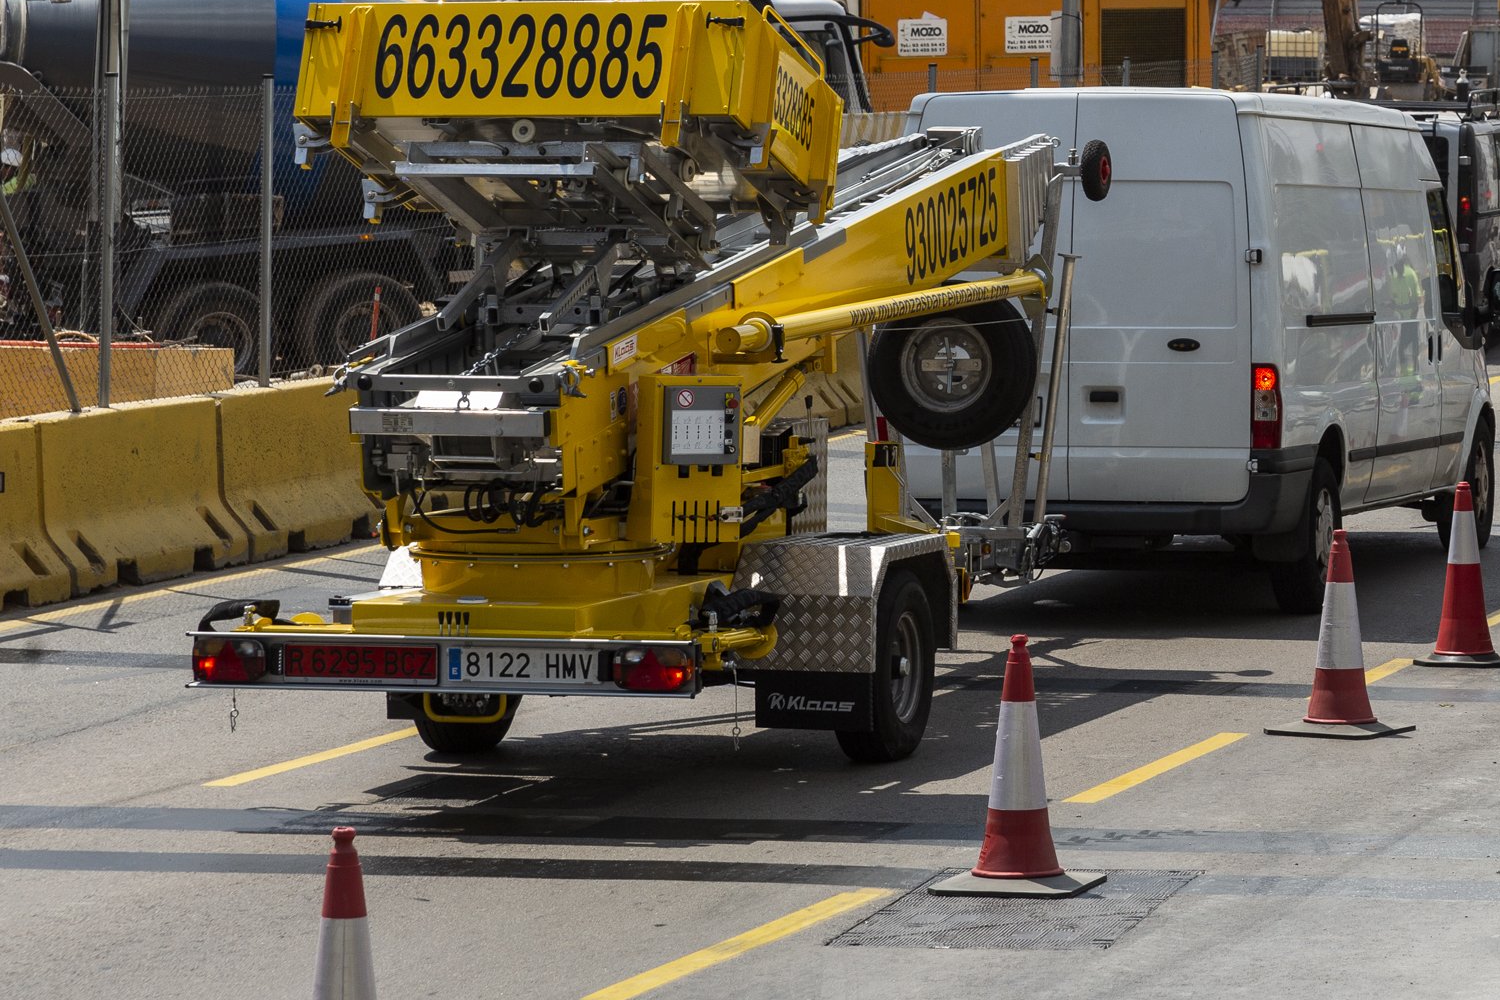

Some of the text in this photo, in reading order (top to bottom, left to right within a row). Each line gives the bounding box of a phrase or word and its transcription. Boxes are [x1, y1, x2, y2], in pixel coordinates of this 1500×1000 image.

[910, 26, 942, 37] MOZO
[1018, 24, 1049, 34] MOZO
[374, 13, 668, 99] 663328885
[774, 65, 815, 152] 3328885
[905, 167, 998, 285] 930025725
[289, 650, 435, 677] R 6295 BCZ
[452, 666, 459, 675] E
[466, 651, 593, 680] 8122 HMV
